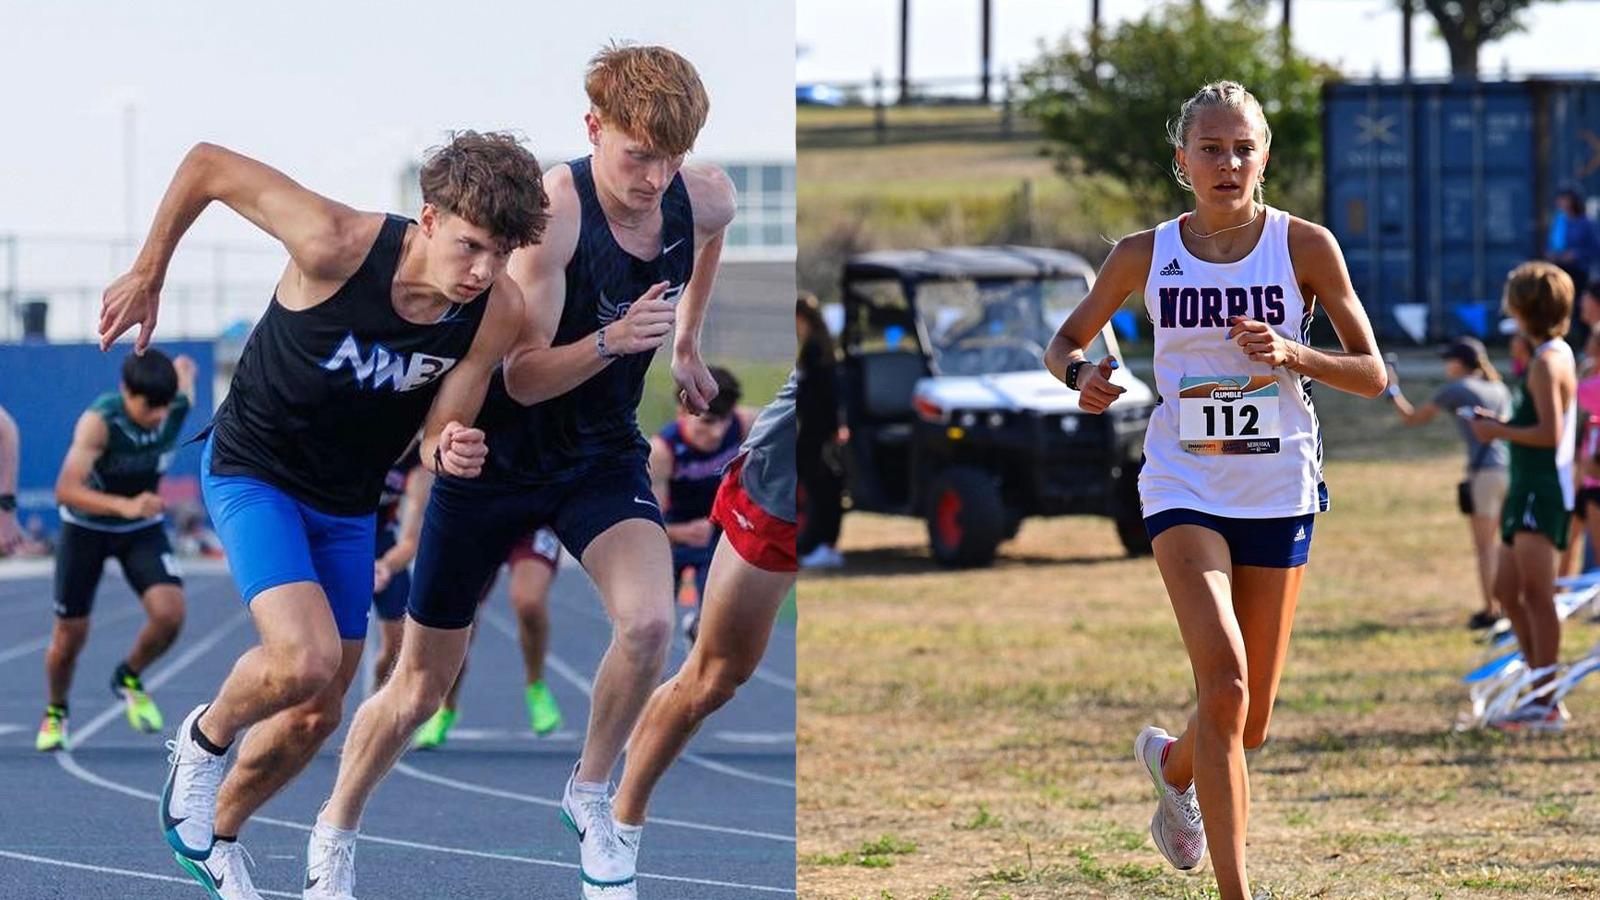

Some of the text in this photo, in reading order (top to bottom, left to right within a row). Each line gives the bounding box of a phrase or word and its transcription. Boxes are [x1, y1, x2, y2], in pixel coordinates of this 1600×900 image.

[1159, 268, 1184, 276] adidas
[1158, 285, 1285, 328] NORRIS
[1214, 391, 1242, 399] RUMBLE
[1202, 404, 1260, 437] 112
